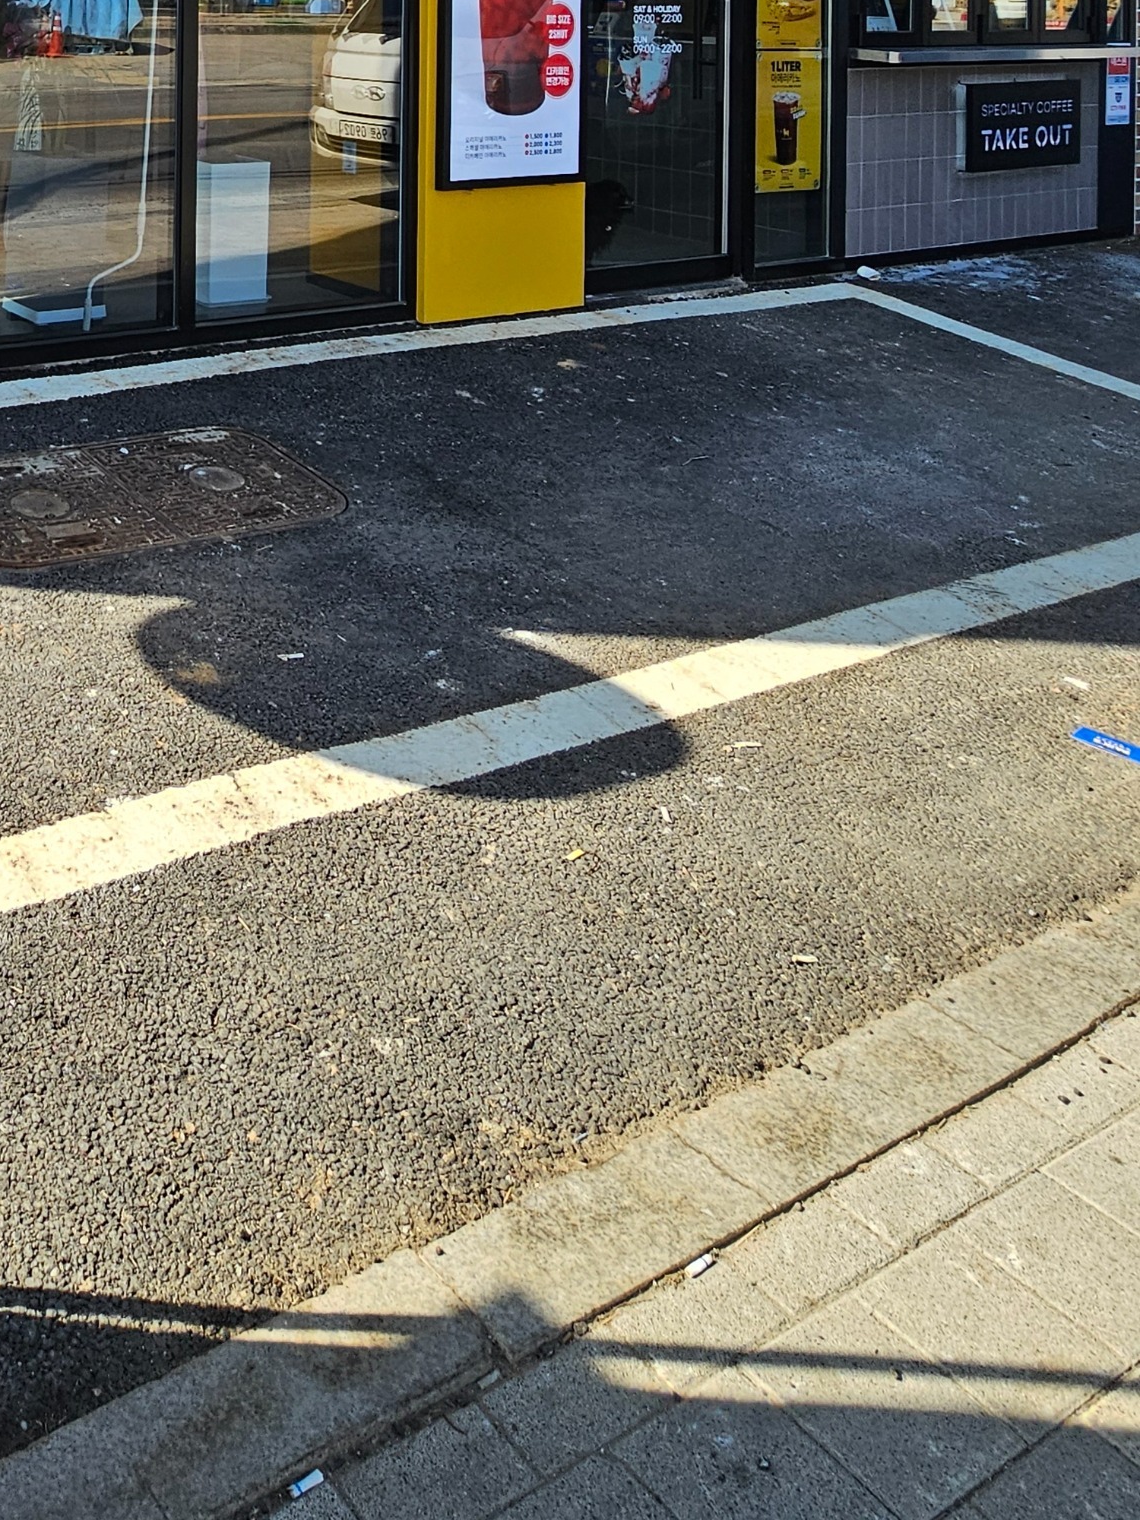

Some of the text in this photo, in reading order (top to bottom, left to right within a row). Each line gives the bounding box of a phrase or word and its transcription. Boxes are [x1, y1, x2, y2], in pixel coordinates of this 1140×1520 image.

[633, 5, 646, 13] SAT
[653, 5, 681, 13] HOLIDAY
[661, 14, 682, 23] 22:00
[776, 61, 801, 72] LITER
[981, 99, 1073, 117] SPECIALTY COFFEE
[981, 124, 1073, 152] TAKE OUT
